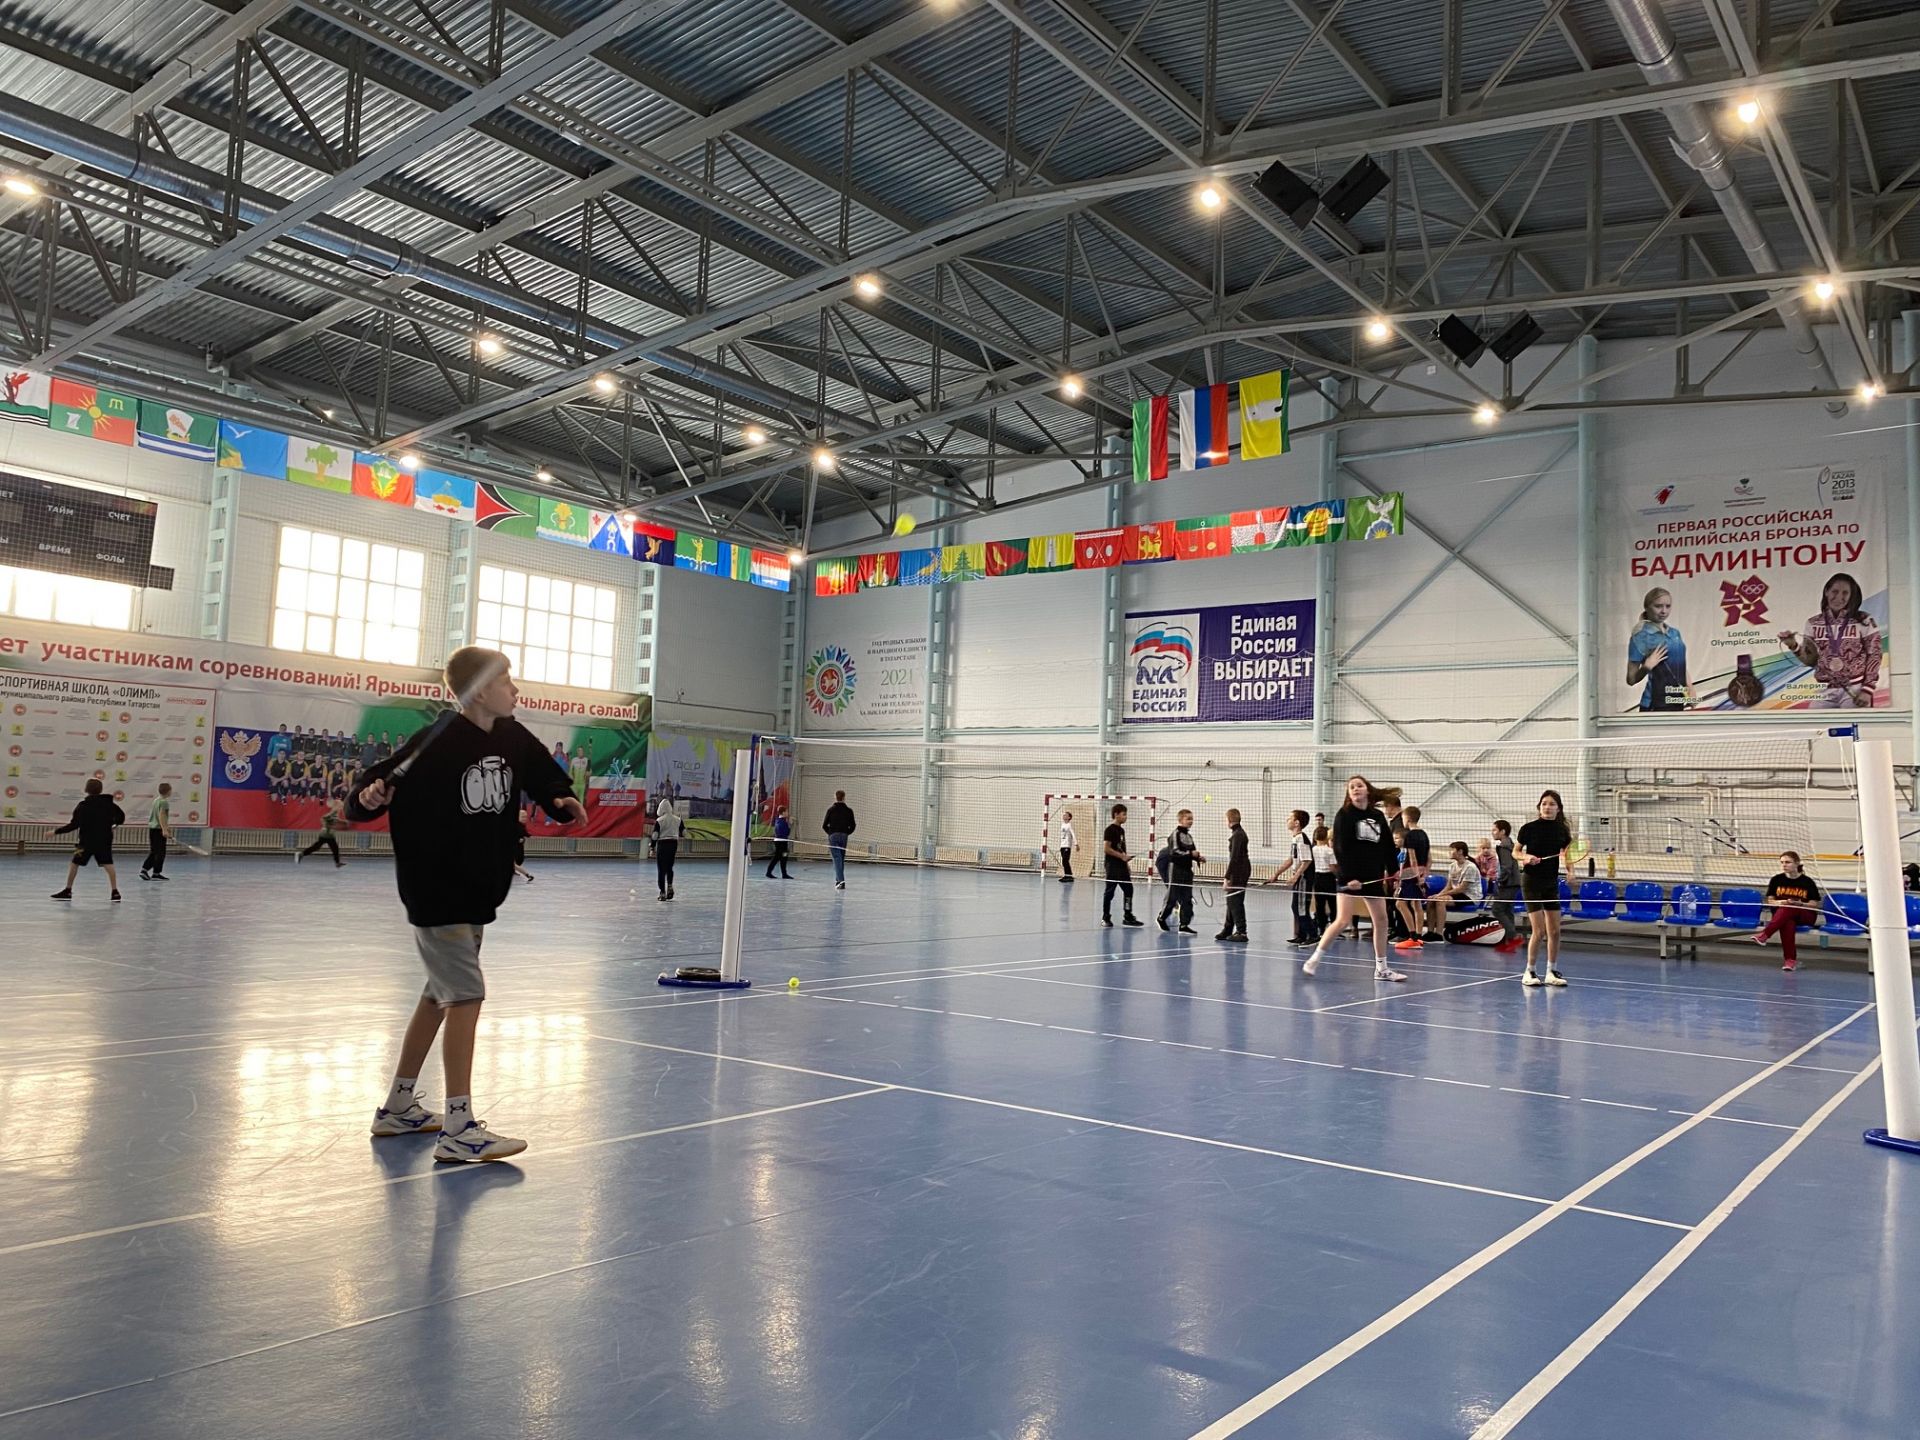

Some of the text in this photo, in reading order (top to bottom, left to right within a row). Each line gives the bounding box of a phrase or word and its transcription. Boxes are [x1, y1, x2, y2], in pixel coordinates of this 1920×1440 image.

[1832, 478, 1855, 490] 2013
[47, 504, 74, 515] ТАЙМ
[108, 511, 132, 521] СЧЕТ
[1657, 508, 1833, 534] ПЕРВАЯ РОССИЙСКАЯ
[1635, 523, 1860, 551] ОЛИМПИЙСКАЯ БРОНЗА ПО
[38, 543, 71, 555] ВРЕМЯ
[96, 552, 126, 564] ФОЛЫ
[1631, 540, 1866, 579] БАДМИНТОНУ
[1231, 615, 1297, 636] Единая
[1728, 630, 1760, 638] London
[1231, 637, 1297, 655] Россия
[1711, 639, 1746, 647] Olympic
[1214, 657, 1313, 681] ВЫБИРАЕТ
[41, 640, 193, 671] участникам
[200, 656, 360, 690] соревнований!
[366, 675, 441, 699] Ярышта
[589, 704, 638, 719] сәлам!
[881, 668, 913, 686] 2021
[0, 675, 161, 700] СПОРТИВНАЯ ШКОЛА «ОЛИМП»
[1132, 688, 1187, 701] ЕДИНАЯ
[1229, 681, 1295, 701] СПОРТ!
[128, 699, 161, 710] Татарстан
[1132, 701, 1187, 713] РОССИЯ
